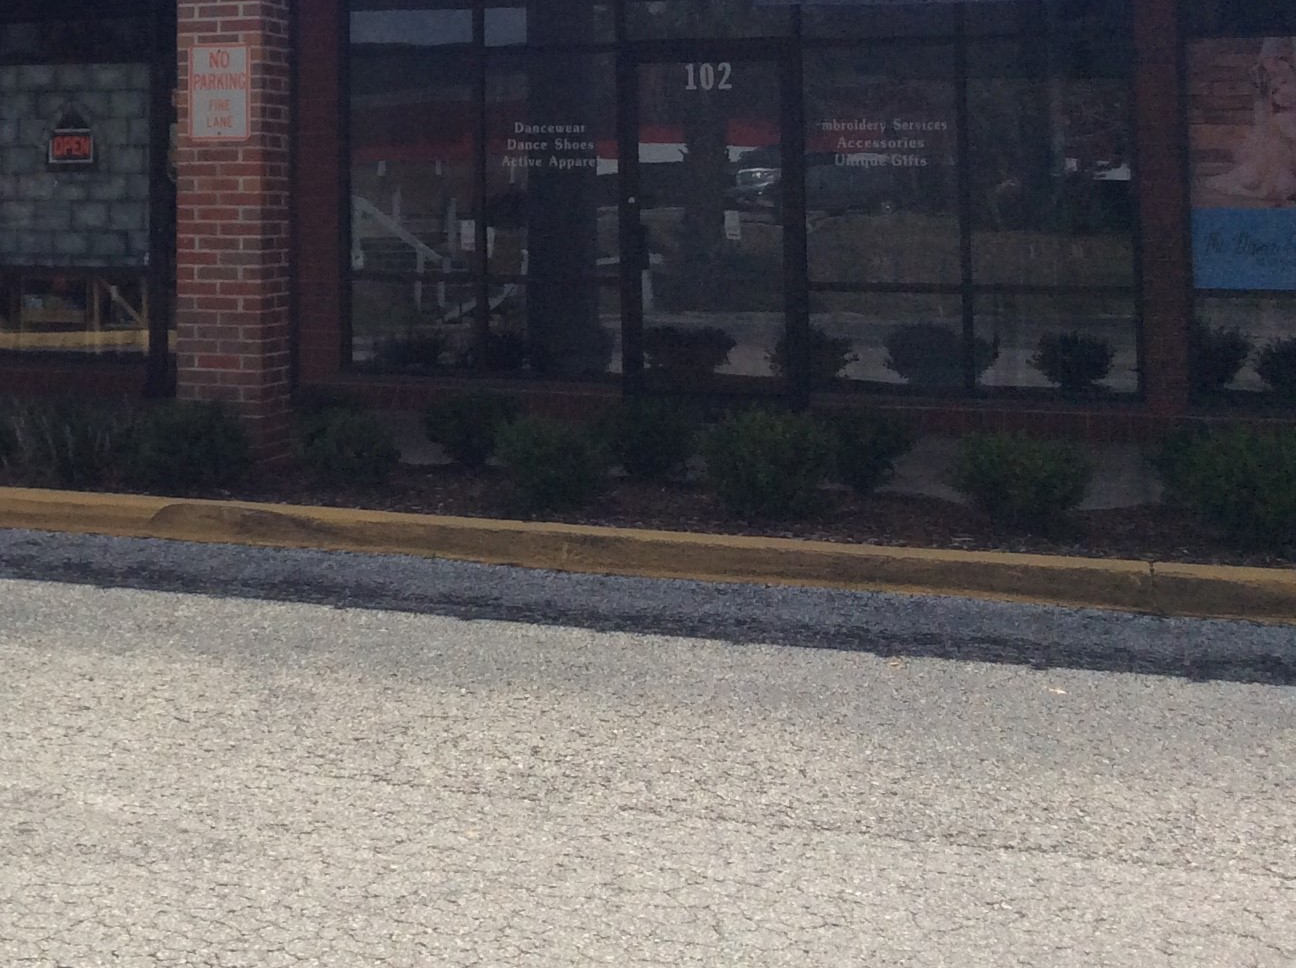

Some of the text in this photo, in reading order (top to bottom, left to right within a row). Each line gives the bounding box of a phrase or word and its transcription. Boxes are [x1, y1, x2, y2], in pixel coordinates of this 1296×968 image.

[208, 50, 230, 69] NO
[193, 72, 246, 90] PARKING
[684, 62, 733, 90] 102
[206, 115, 234, 129] LANE
[514, 121, 586, 134] Dancewear
[893, 118, 948, 132] Services
[53, 136, 90, 156] OPEN
[507, 138, 594, 150] Dance Shoes
[836, 136, 925, 149] Accessories
[501, 155, 542, 167] Active
[892, 153, 928, 167] Gifts
